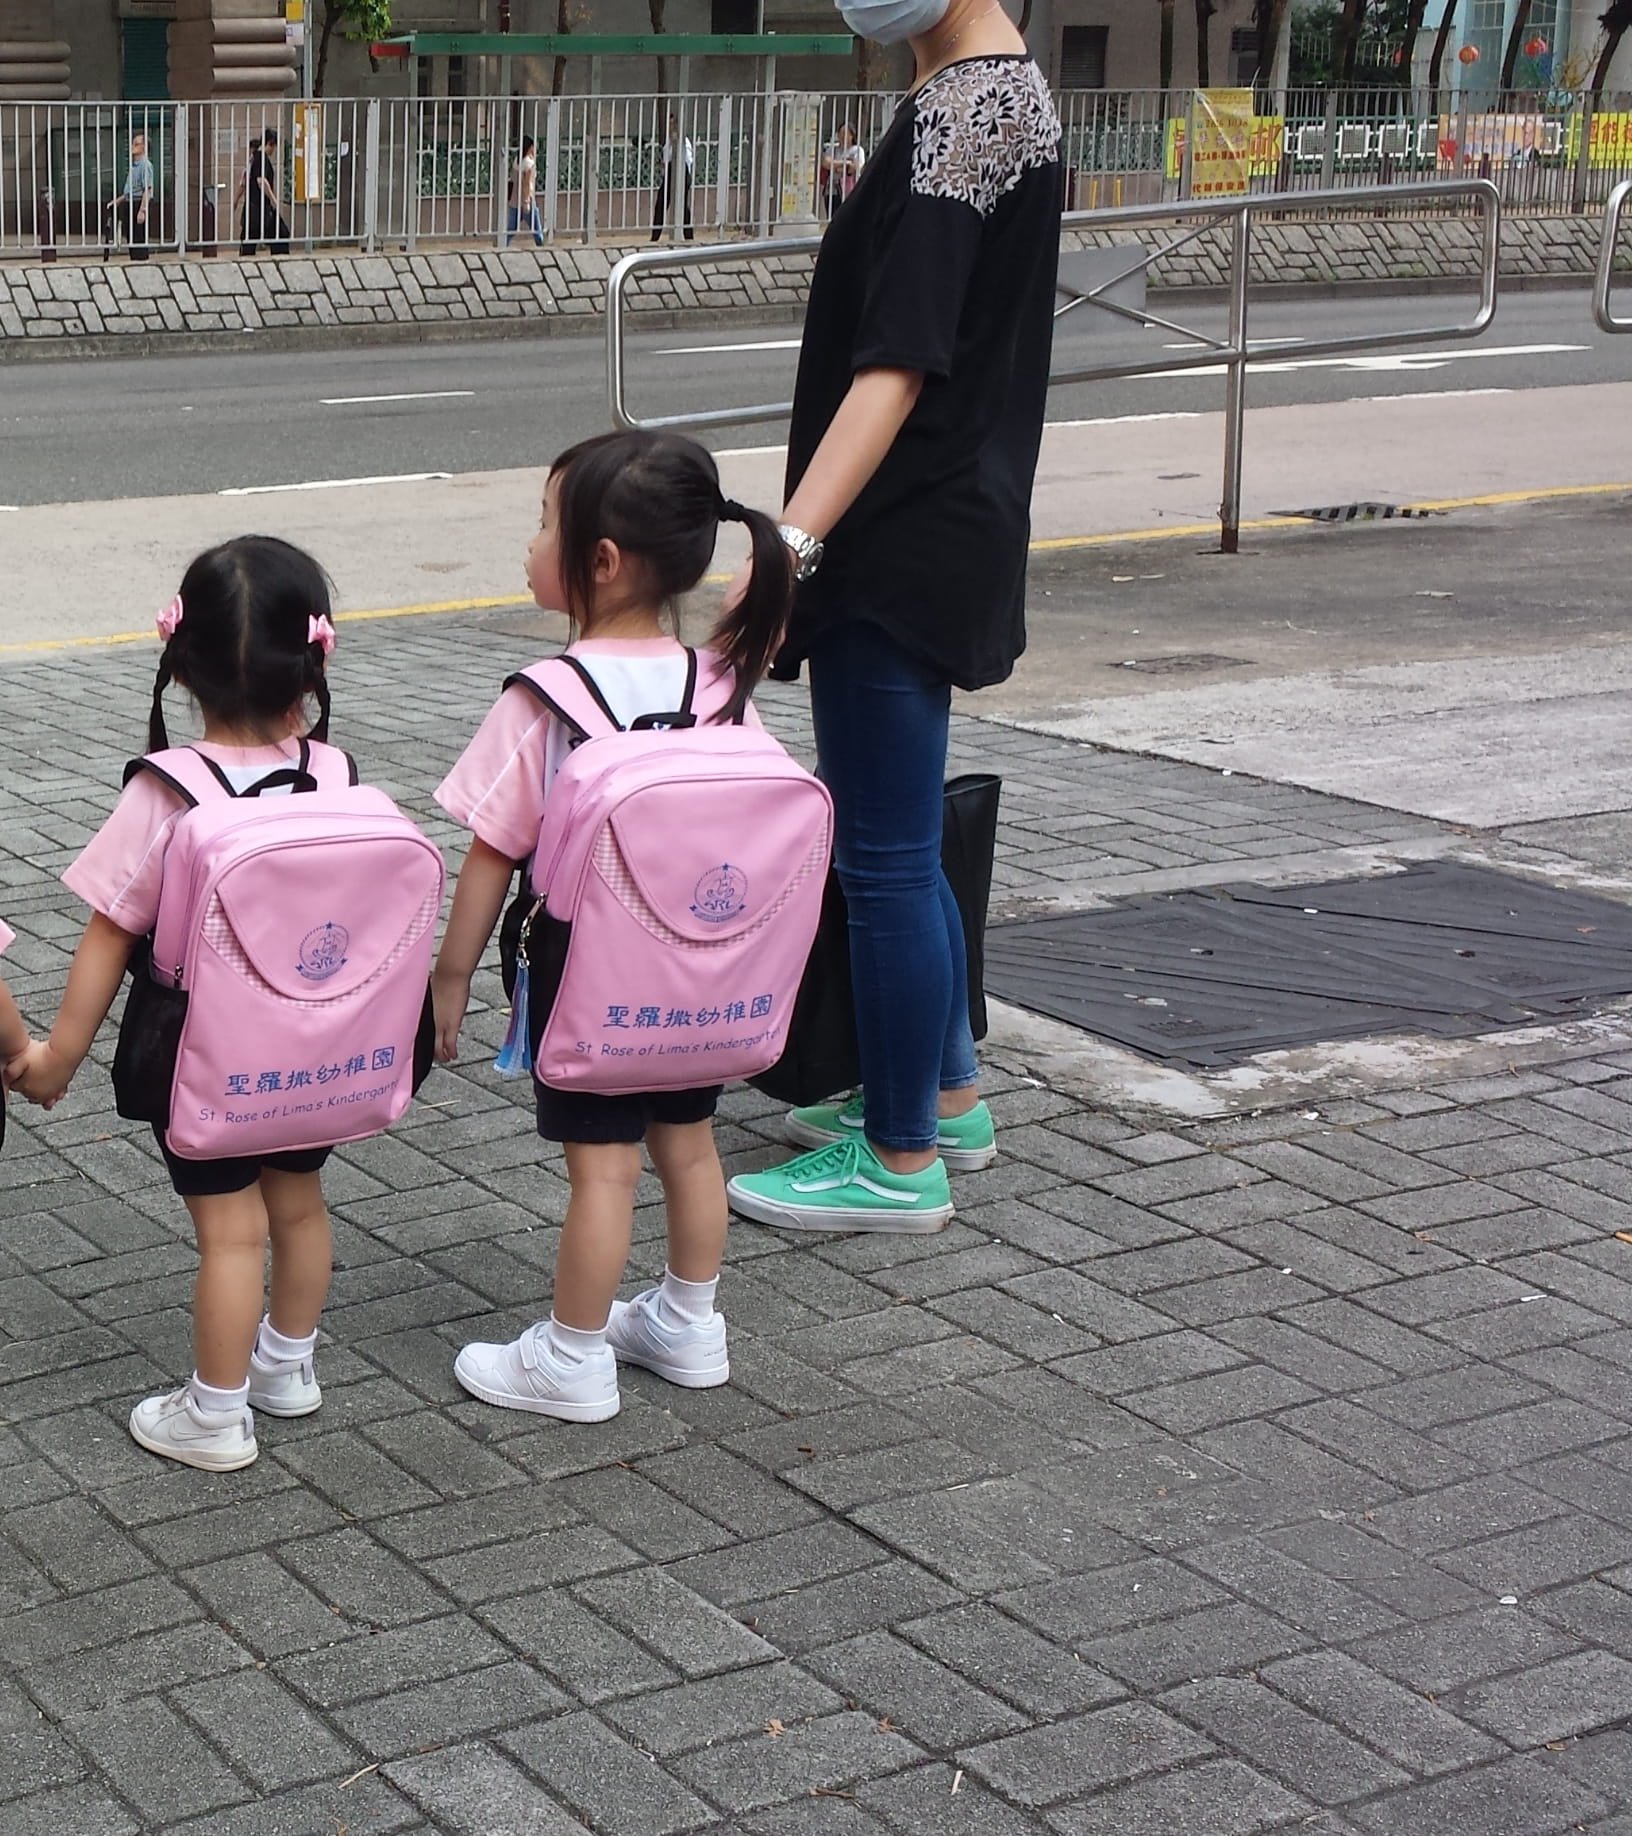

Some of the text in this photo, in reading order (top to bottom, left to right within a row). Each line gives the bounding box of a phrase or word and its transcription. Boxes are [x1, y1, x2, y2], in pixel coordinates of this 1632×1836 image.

[602, 993, 773, 1029] 聖羅撒幼稚園
[601, 1043, 634, 1057] Rose
[638, 1044, 655, 1056] of
[658, 1043, 701, 1055] Lima's
[224, 1046, 395, 1097] 聖羅撒幼稚園
[225, 1111, 258, 1124] Rose
[262, 1106, 279, 1119] of
[282, 1099, 324, 1115] Lima's
